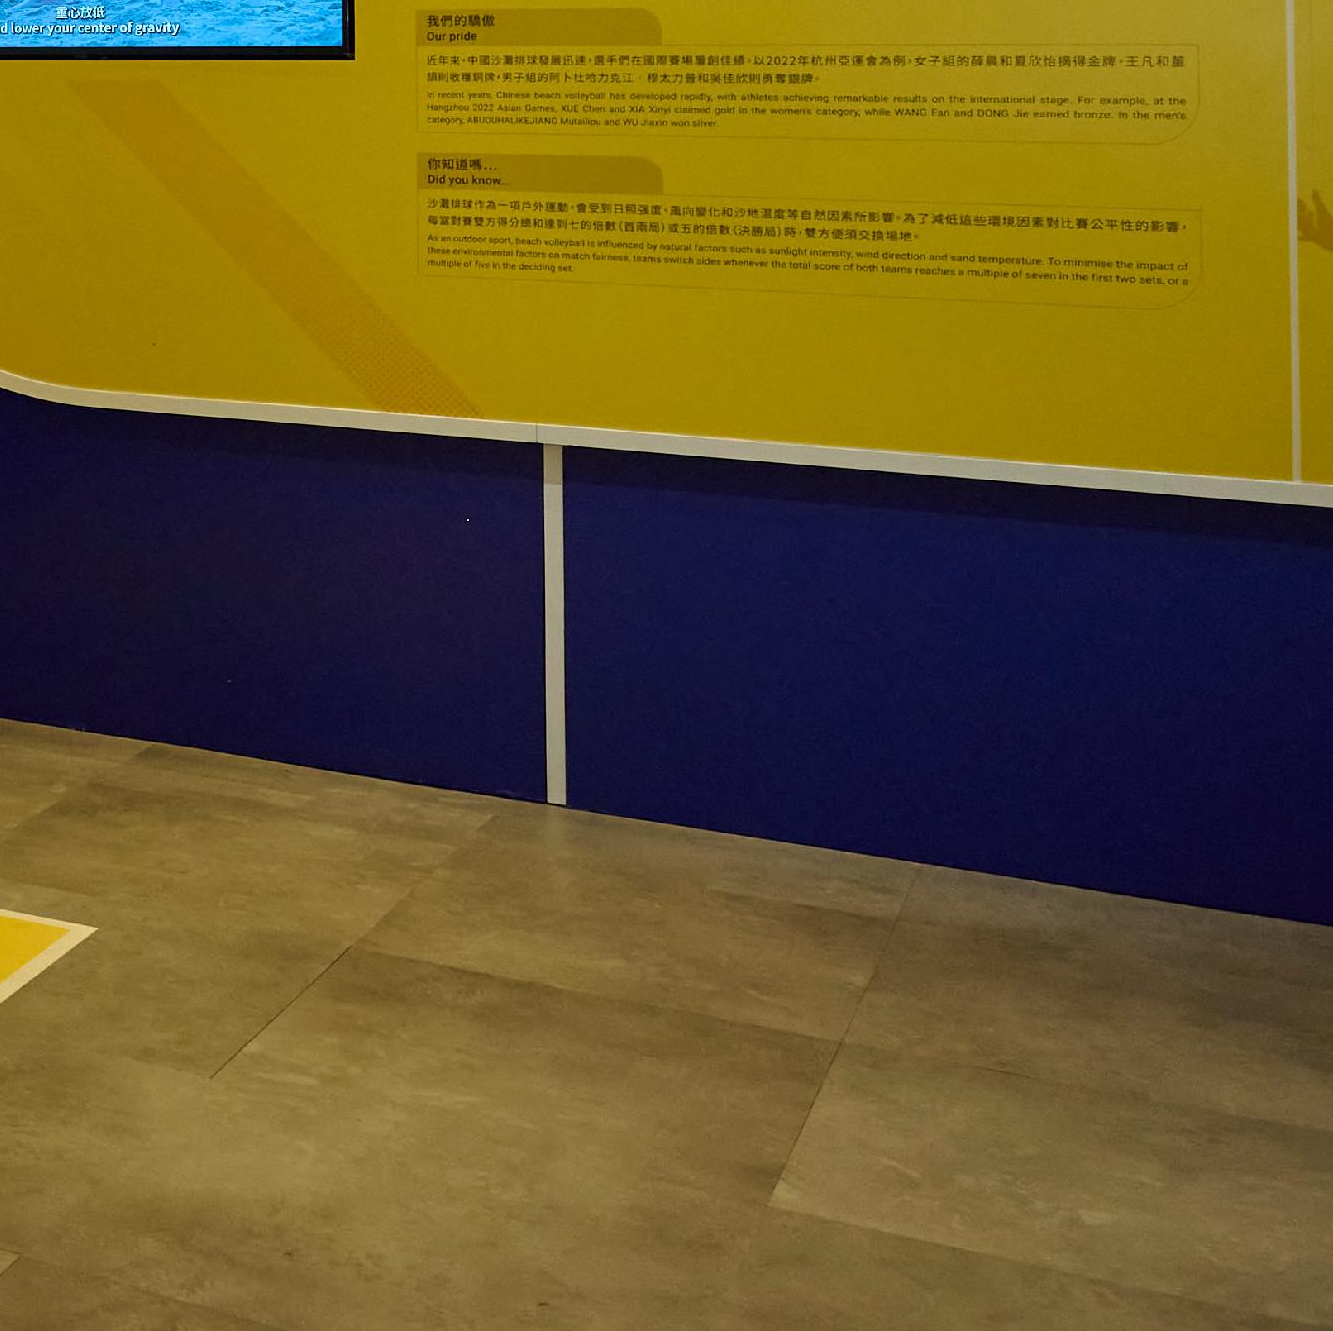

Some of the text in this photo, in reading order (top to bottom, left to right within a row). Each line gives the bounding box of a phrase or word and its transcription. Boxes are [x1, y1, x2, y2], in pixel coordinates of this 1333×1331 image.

[55, 6, 105, 20] 重心放低
[11, 23, 44, 34] lower
[47, 24, 76, 37] your
[78, 23, 117, 34] center
[119, 22, 133, 34] of
[135, 23, 180, 37] gravity
[426, 30, 476, 43] Our pride
[427, 174, 446, 185] Did
[449, 176, 469, 188] you
